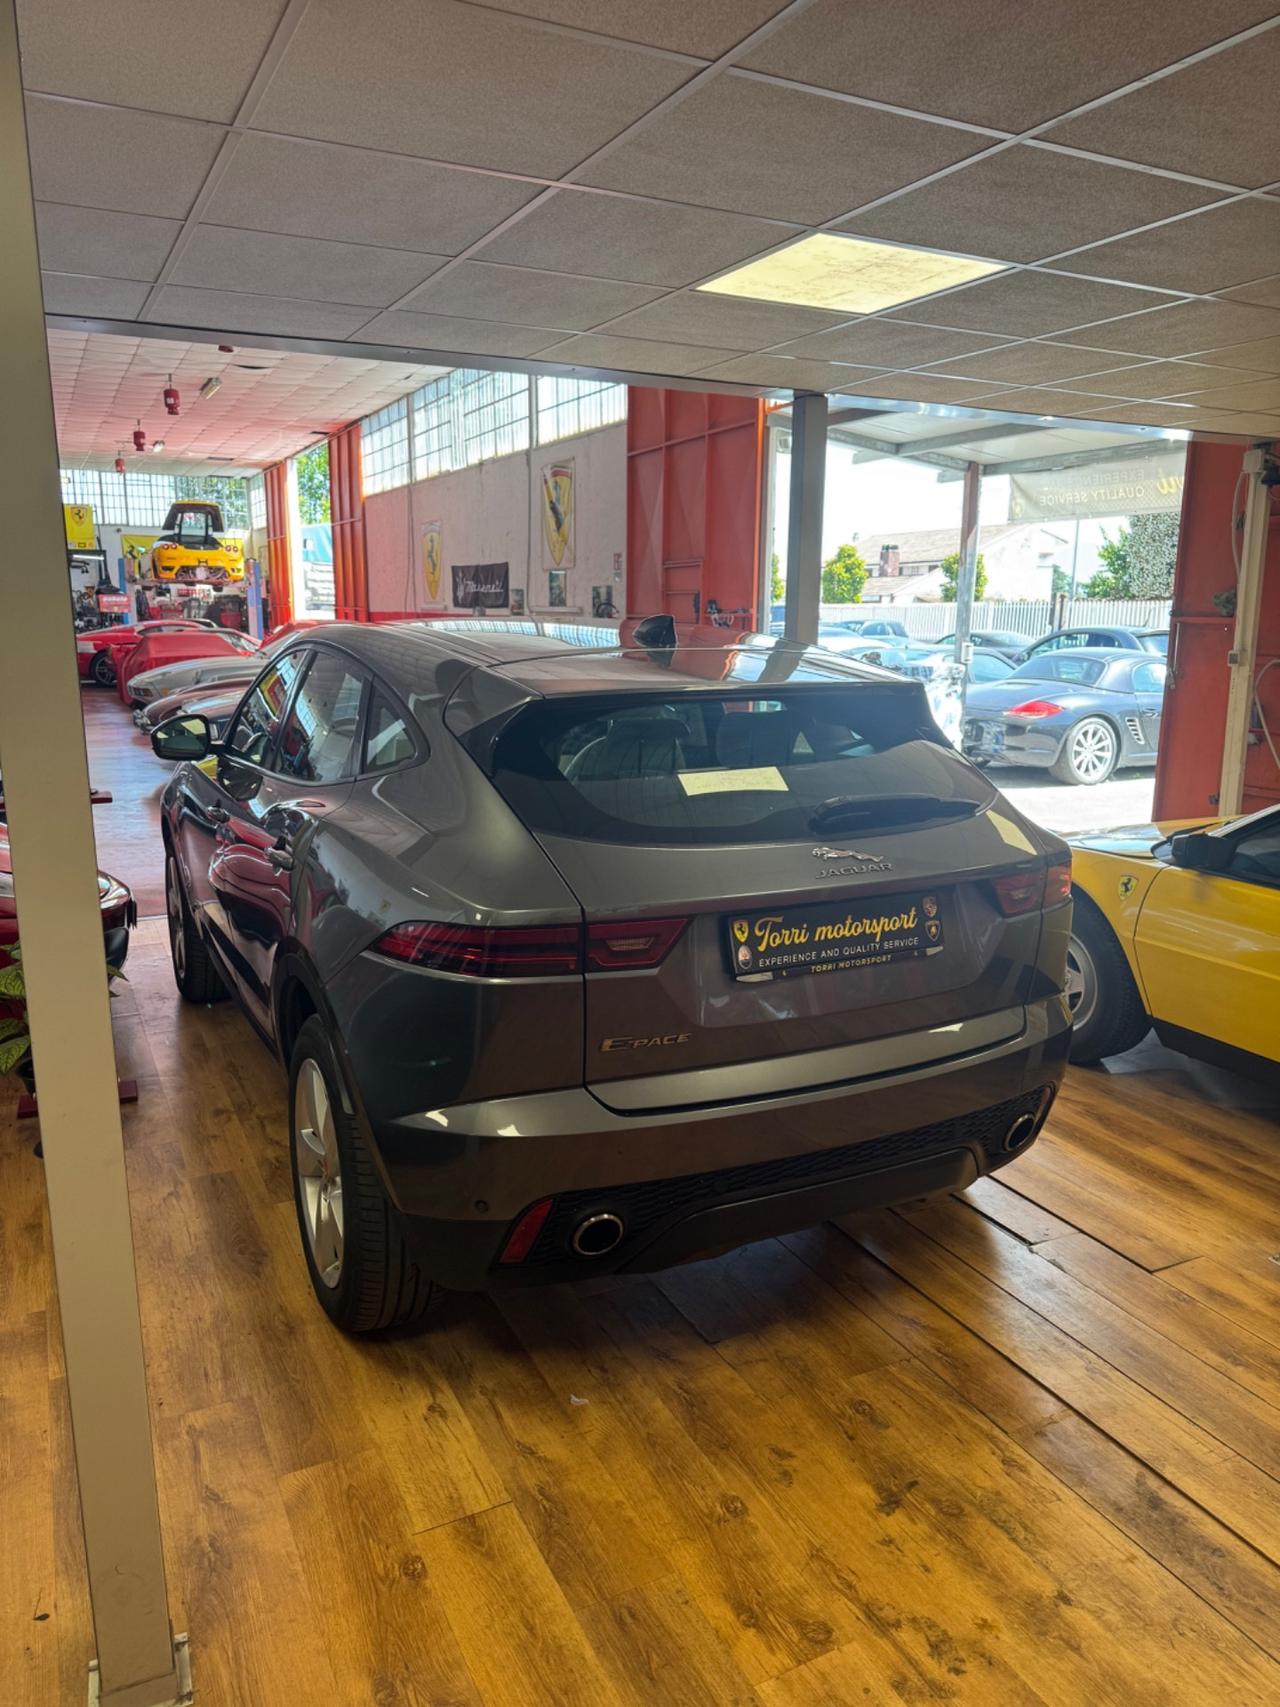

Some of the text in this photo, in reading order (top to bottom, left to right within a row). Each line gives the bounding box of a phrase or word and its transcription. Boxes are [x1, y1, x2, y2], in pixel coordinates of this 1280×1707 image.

[815, 863, 893, 879] JAGUAR
[754, 907, 918, 952] Torri motorsport
[759, 937, 919, 968] EXPERIENCE AND QUALITY SERVICE
[811, 955, 892, 973] TORRI MOTORSPORT
